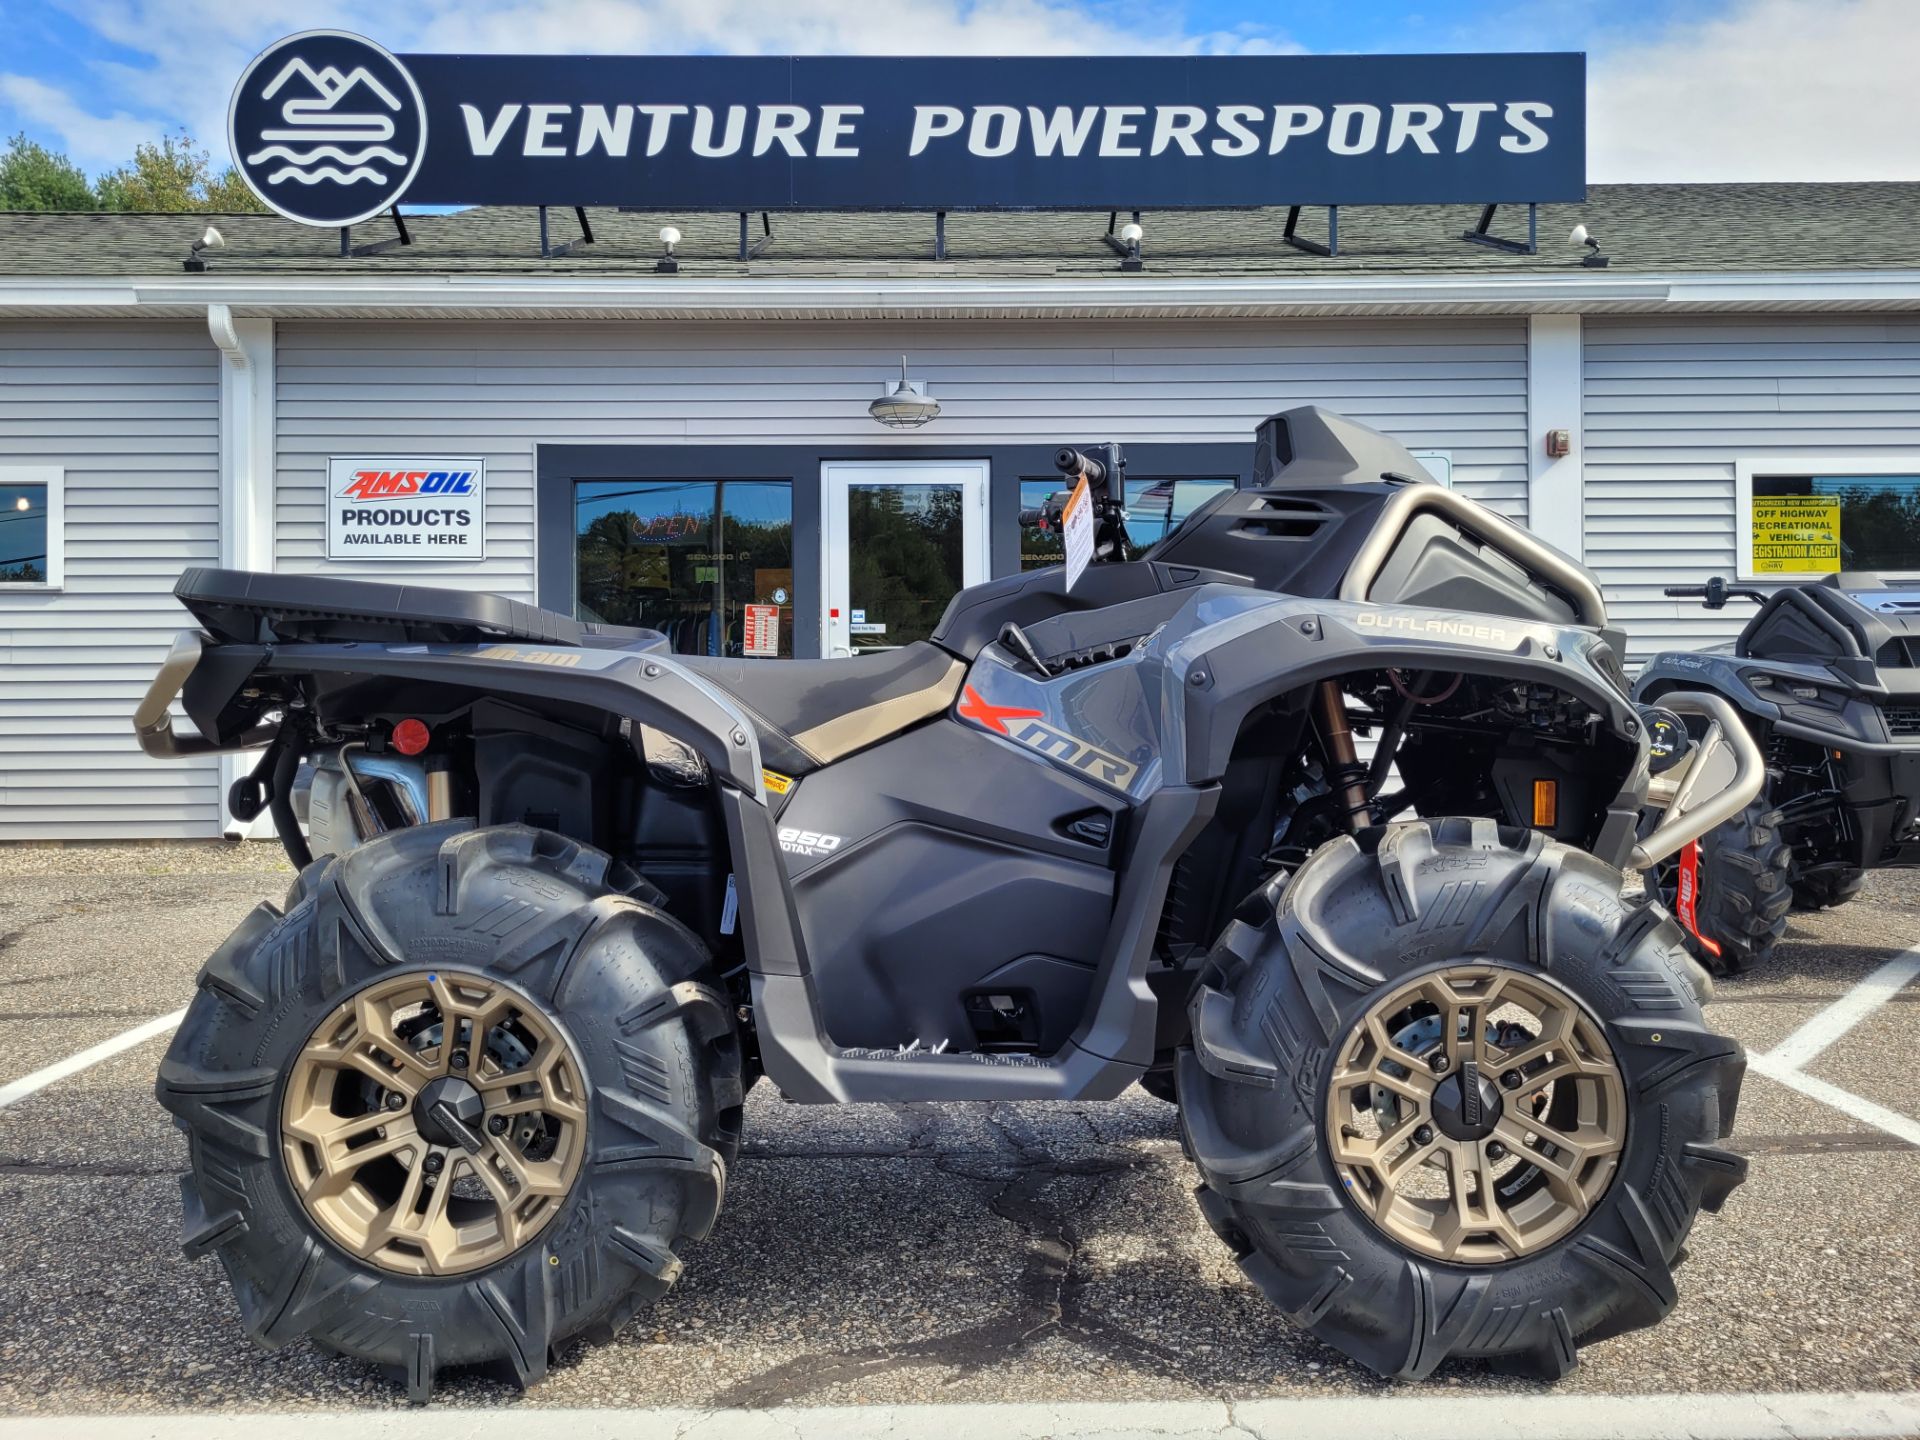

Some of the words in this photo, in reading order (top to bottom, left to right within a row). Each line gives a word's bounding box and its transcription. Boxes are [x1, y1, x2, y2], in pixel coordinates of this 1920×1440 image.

[459, 104, 865, 157] VENTURE
[909, 102, 1554, 157] POWERSPORTS
[343, 471, 473, 500] AMSOIL
[342, 509, 471, 526] PRODUCTS
[1756, 510, 1776, 518] OFF
[1780, 510, 1828, 518] HIGHWAY
[632, 515, 700, 535] OPEN
[1753, 522, 1832, 530] RECREATIONAL
[343, 534, 421, 545] AVAILABLE
[427, 534, 468, 545] HERE
[1769, 533, 1814, 541] VEHICLE
[1754, 546, 1807, 558] EGISTRATION
[1809, 546, 1837, 558] AGENT
[1357, 612, 1505, 642] OUTLANDER
[777, 828, 841, 850] 850
